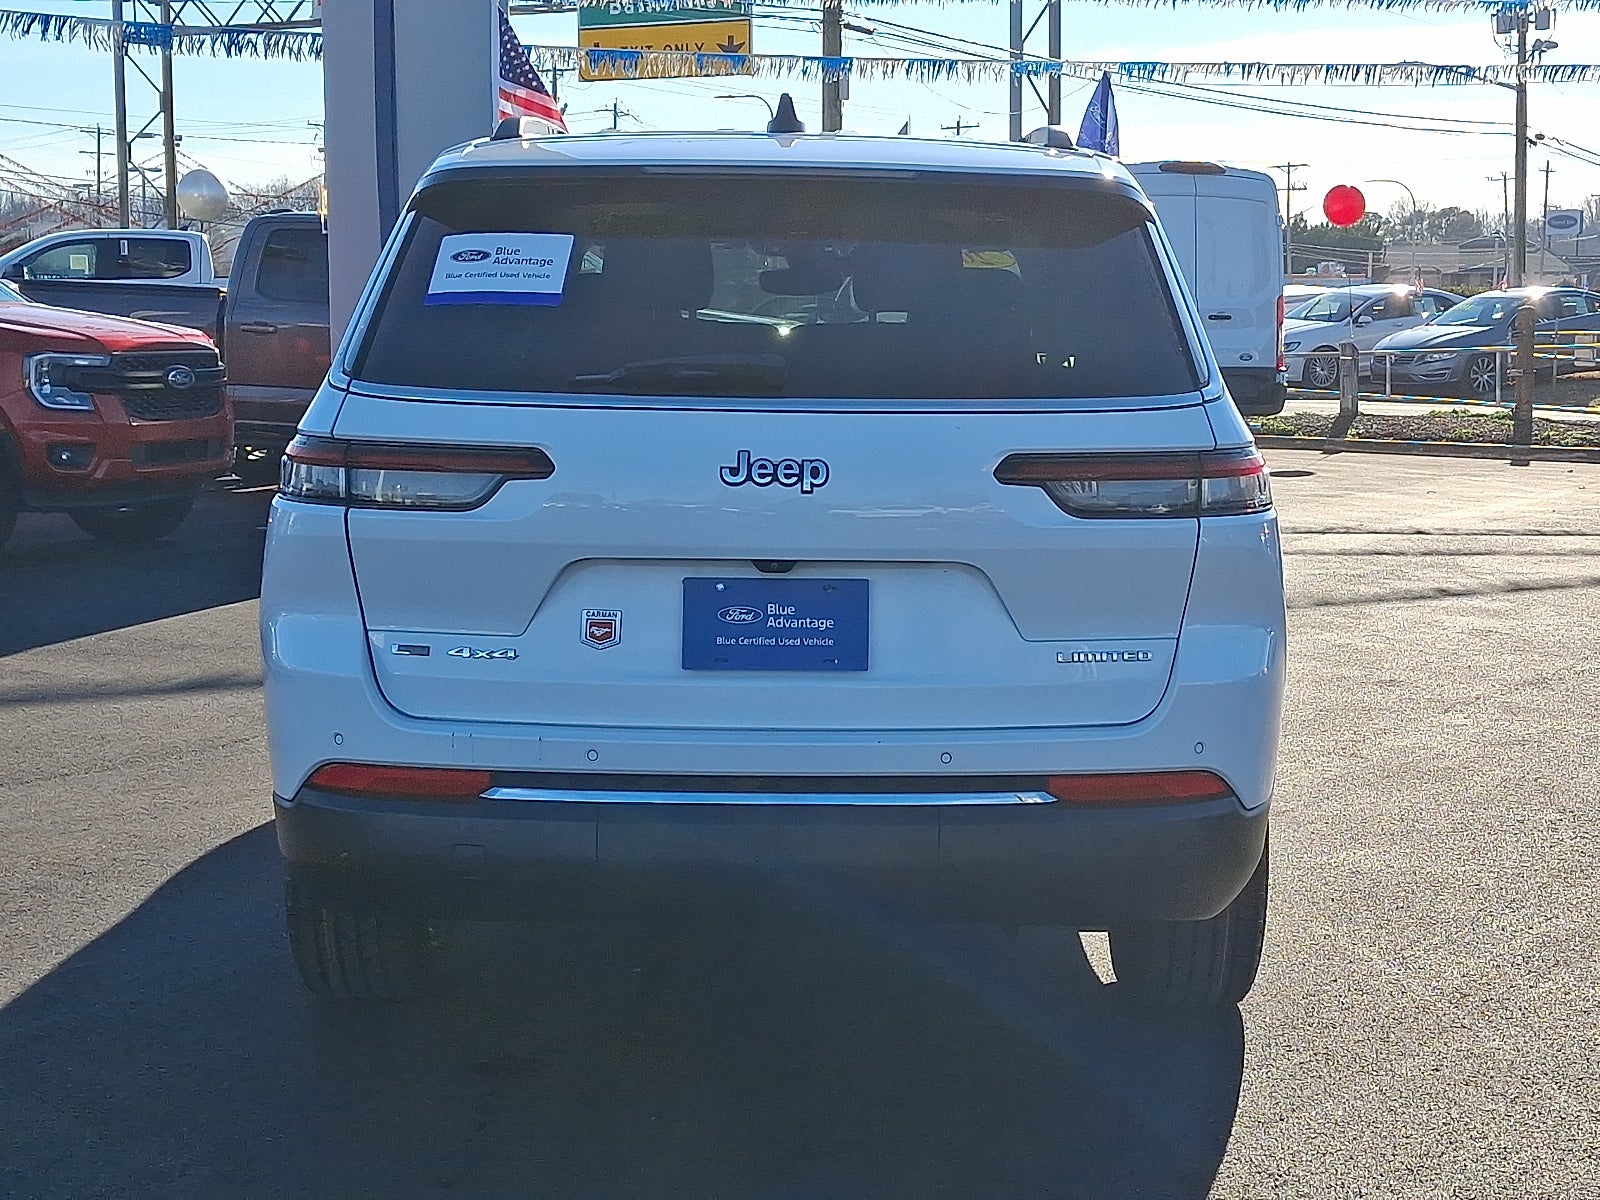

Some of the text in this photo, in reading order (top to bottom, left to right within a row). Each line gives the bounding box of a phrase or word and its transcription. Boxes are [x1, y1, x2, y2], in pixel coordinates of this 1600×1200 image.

[495, 247, 521, 256] Blue
[492, 256, 554, 268] Advantage
[464, 271, 497, 279] Certified
[499, 271, 520, 279] Used
[522, 272, 551, 280] Vehicle
[720, 449, 830, 495] Jeep
[725, 608, 755, 621] Ford
[766, 603, 796, 616] Blue
[766, 616, 835, 631] Advantage
[716, 636, 835, 646] Blue Certified Used Vehicle
[447, 646, 519, 661] 4x4
[1056, 650, 1152, 663] LIMITED
